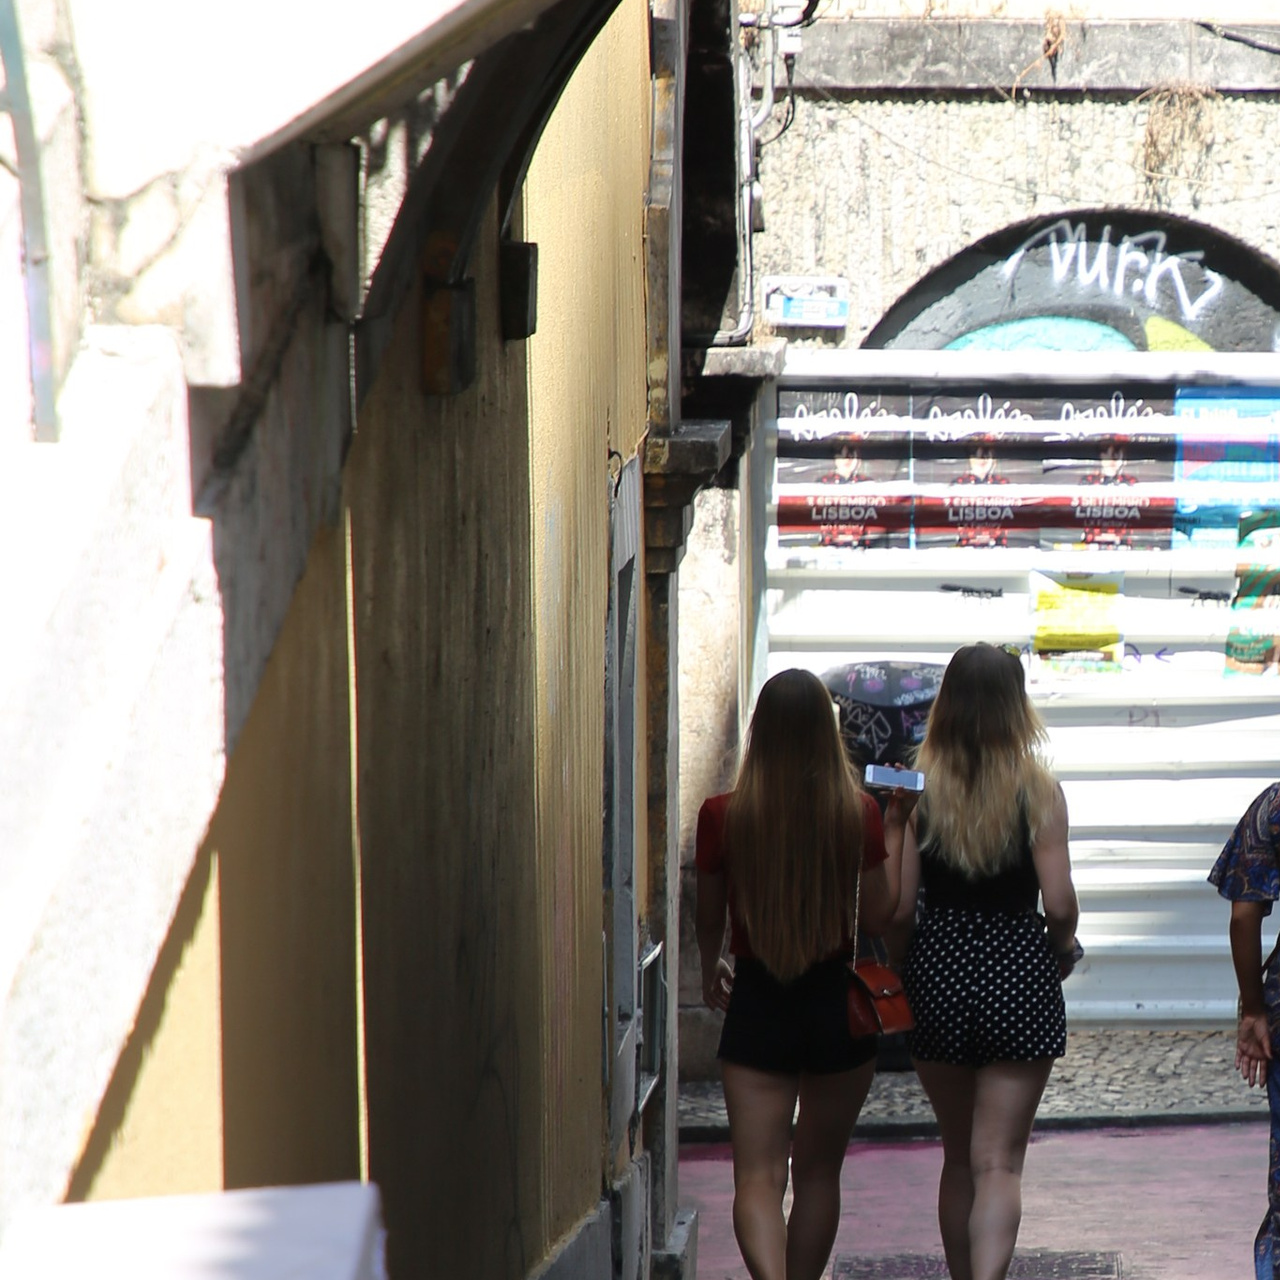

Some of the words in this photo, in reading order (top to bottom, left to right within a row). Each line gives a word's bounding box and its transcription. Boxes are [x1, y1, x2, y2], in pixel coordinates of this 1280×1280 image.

[812, 506, 878, 520] LISBOA
[948, 507, 1015, 521] LISBOA
[1075, 506, 1141, 519] LISBOA
